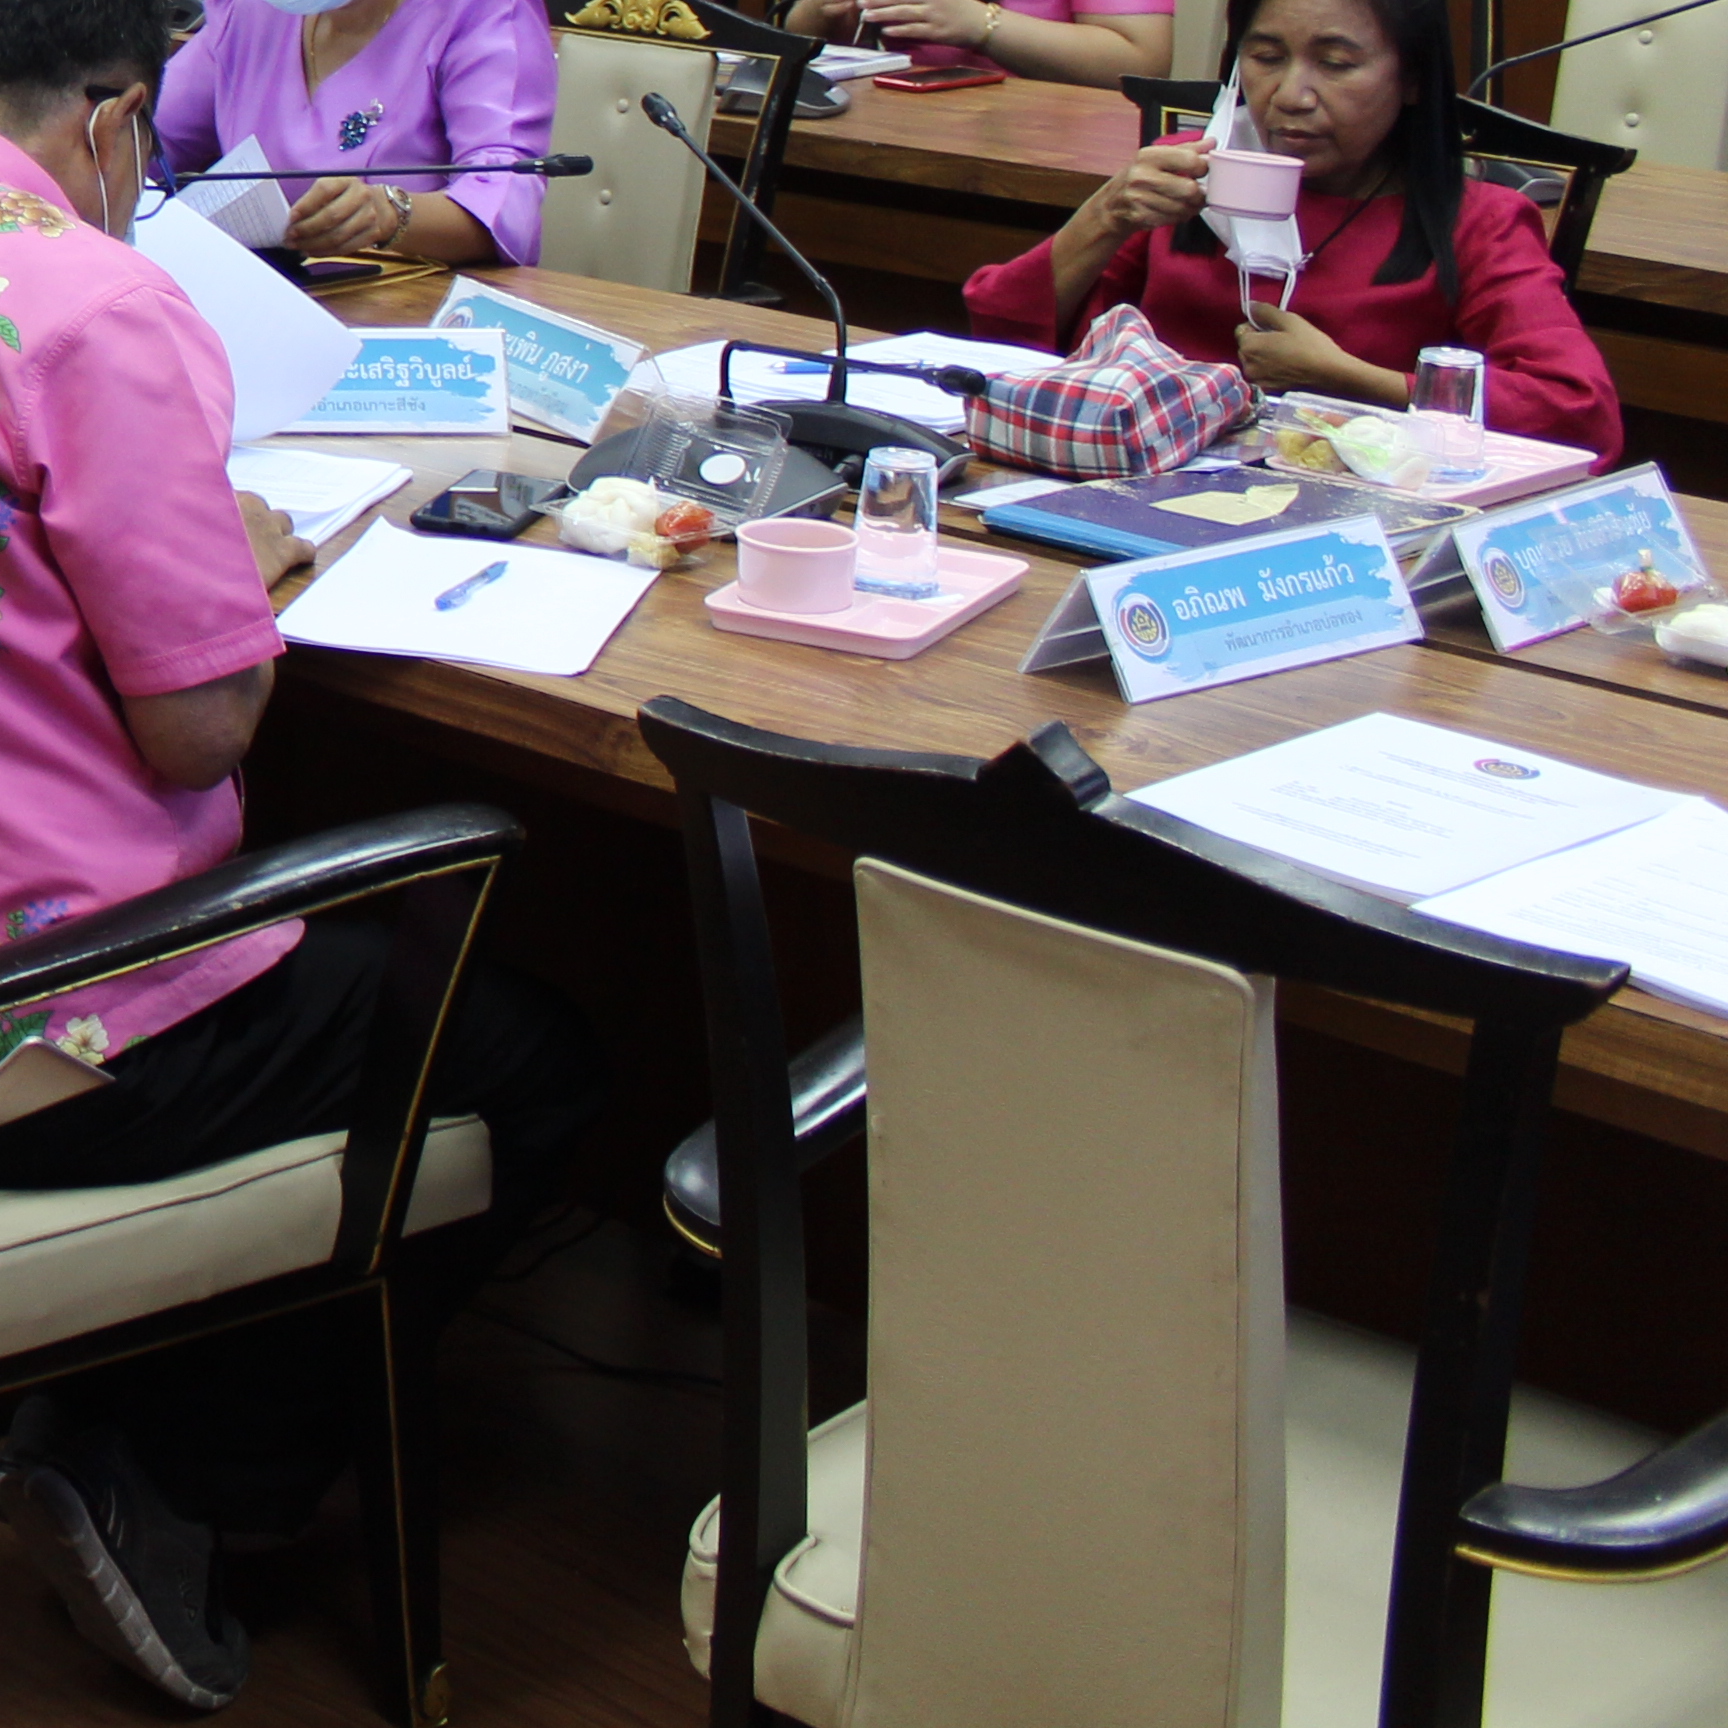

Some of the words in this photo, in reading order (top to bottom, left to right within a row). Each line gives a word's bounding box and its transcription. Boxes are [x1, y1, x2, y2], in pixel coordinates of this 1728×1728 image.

[1172, 585, 1247, 621] อภิณพ
[1257, 554, 1355, 602] มังกรแก้ว
[1224, 609, 1364, 652] พัฒนาการอำเภอบ่อทอง
